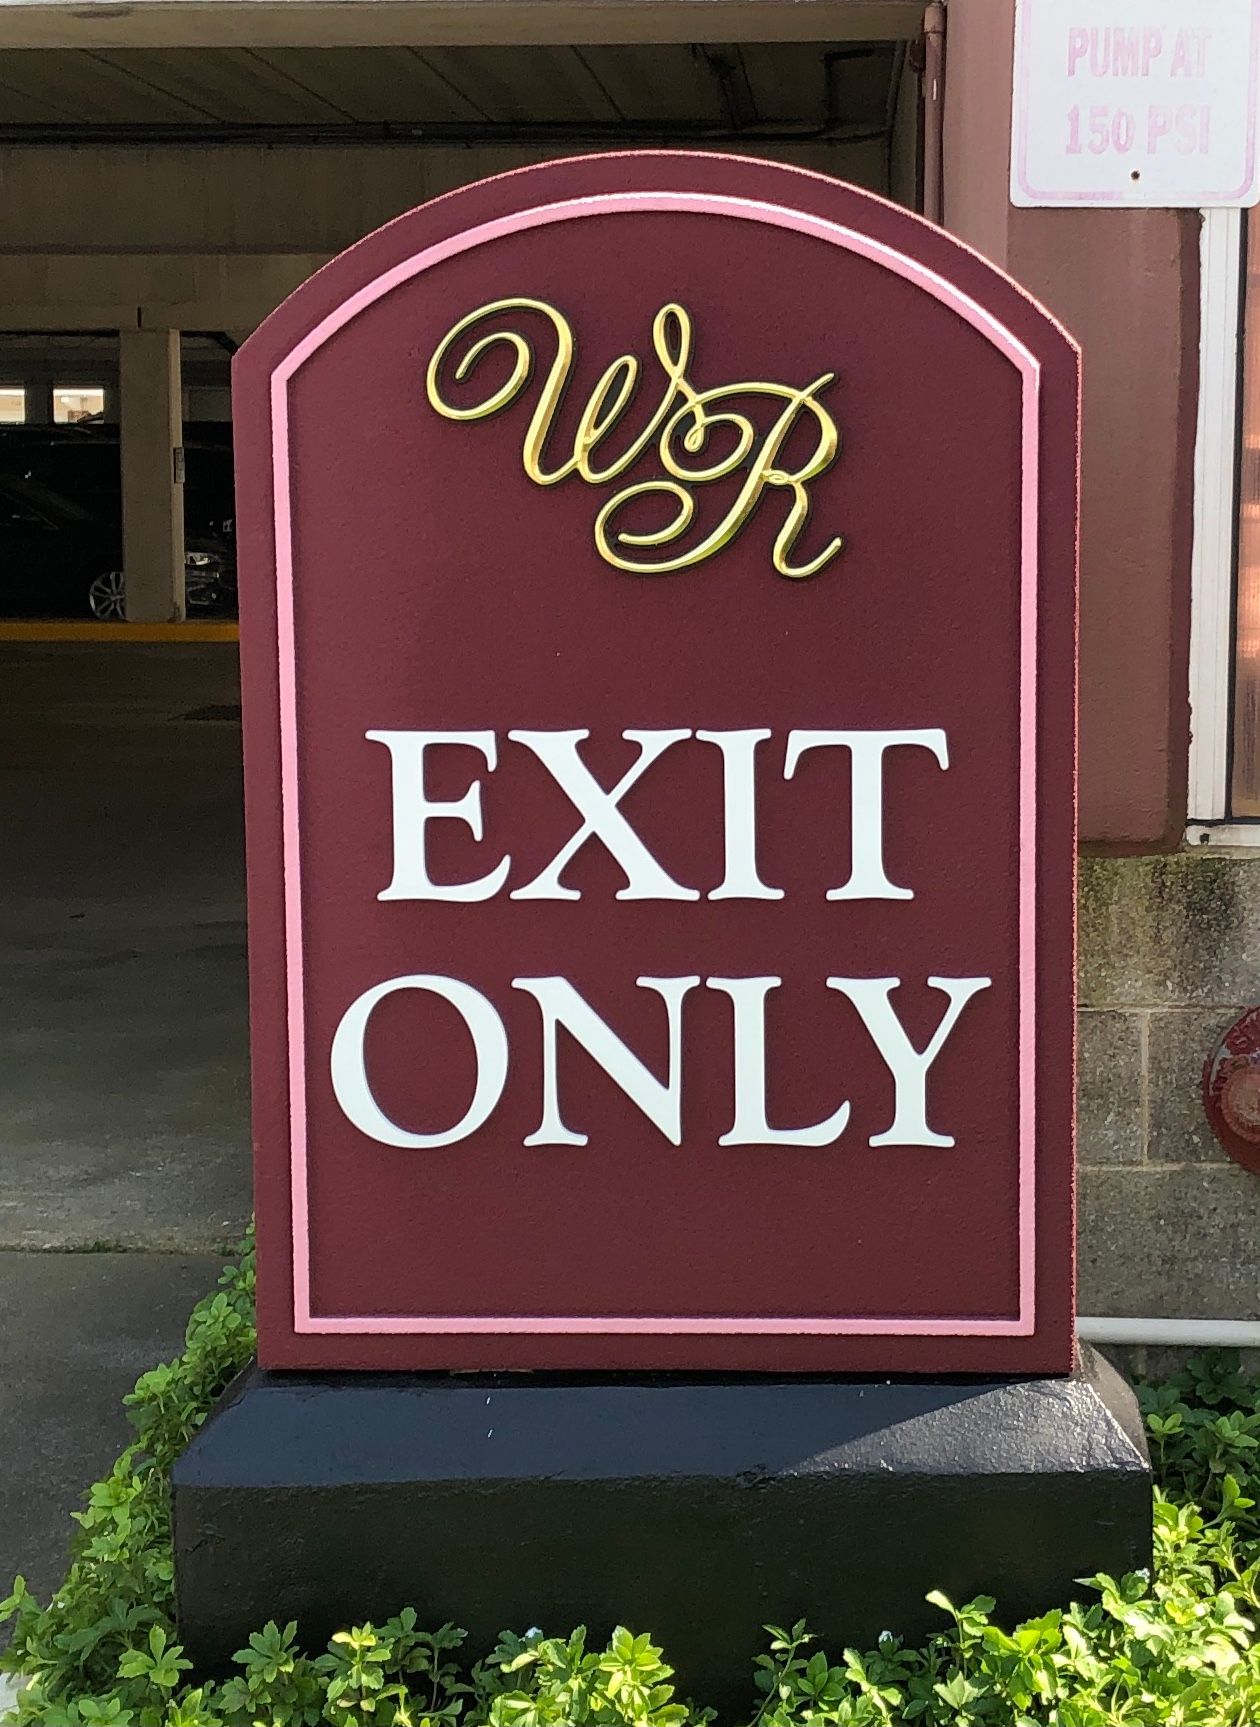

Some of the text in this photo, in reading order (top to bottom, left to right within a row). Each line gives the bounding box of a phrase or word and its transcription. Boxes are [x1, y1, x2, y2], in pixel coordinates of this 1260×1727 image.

[1067, 27, 1212, 78] PUMP AT
[1065, 104, 1210, 155] 150 PSI
[365, 728, 950, 902] EXIT
[330, 974, 992, 1148] ONLY
